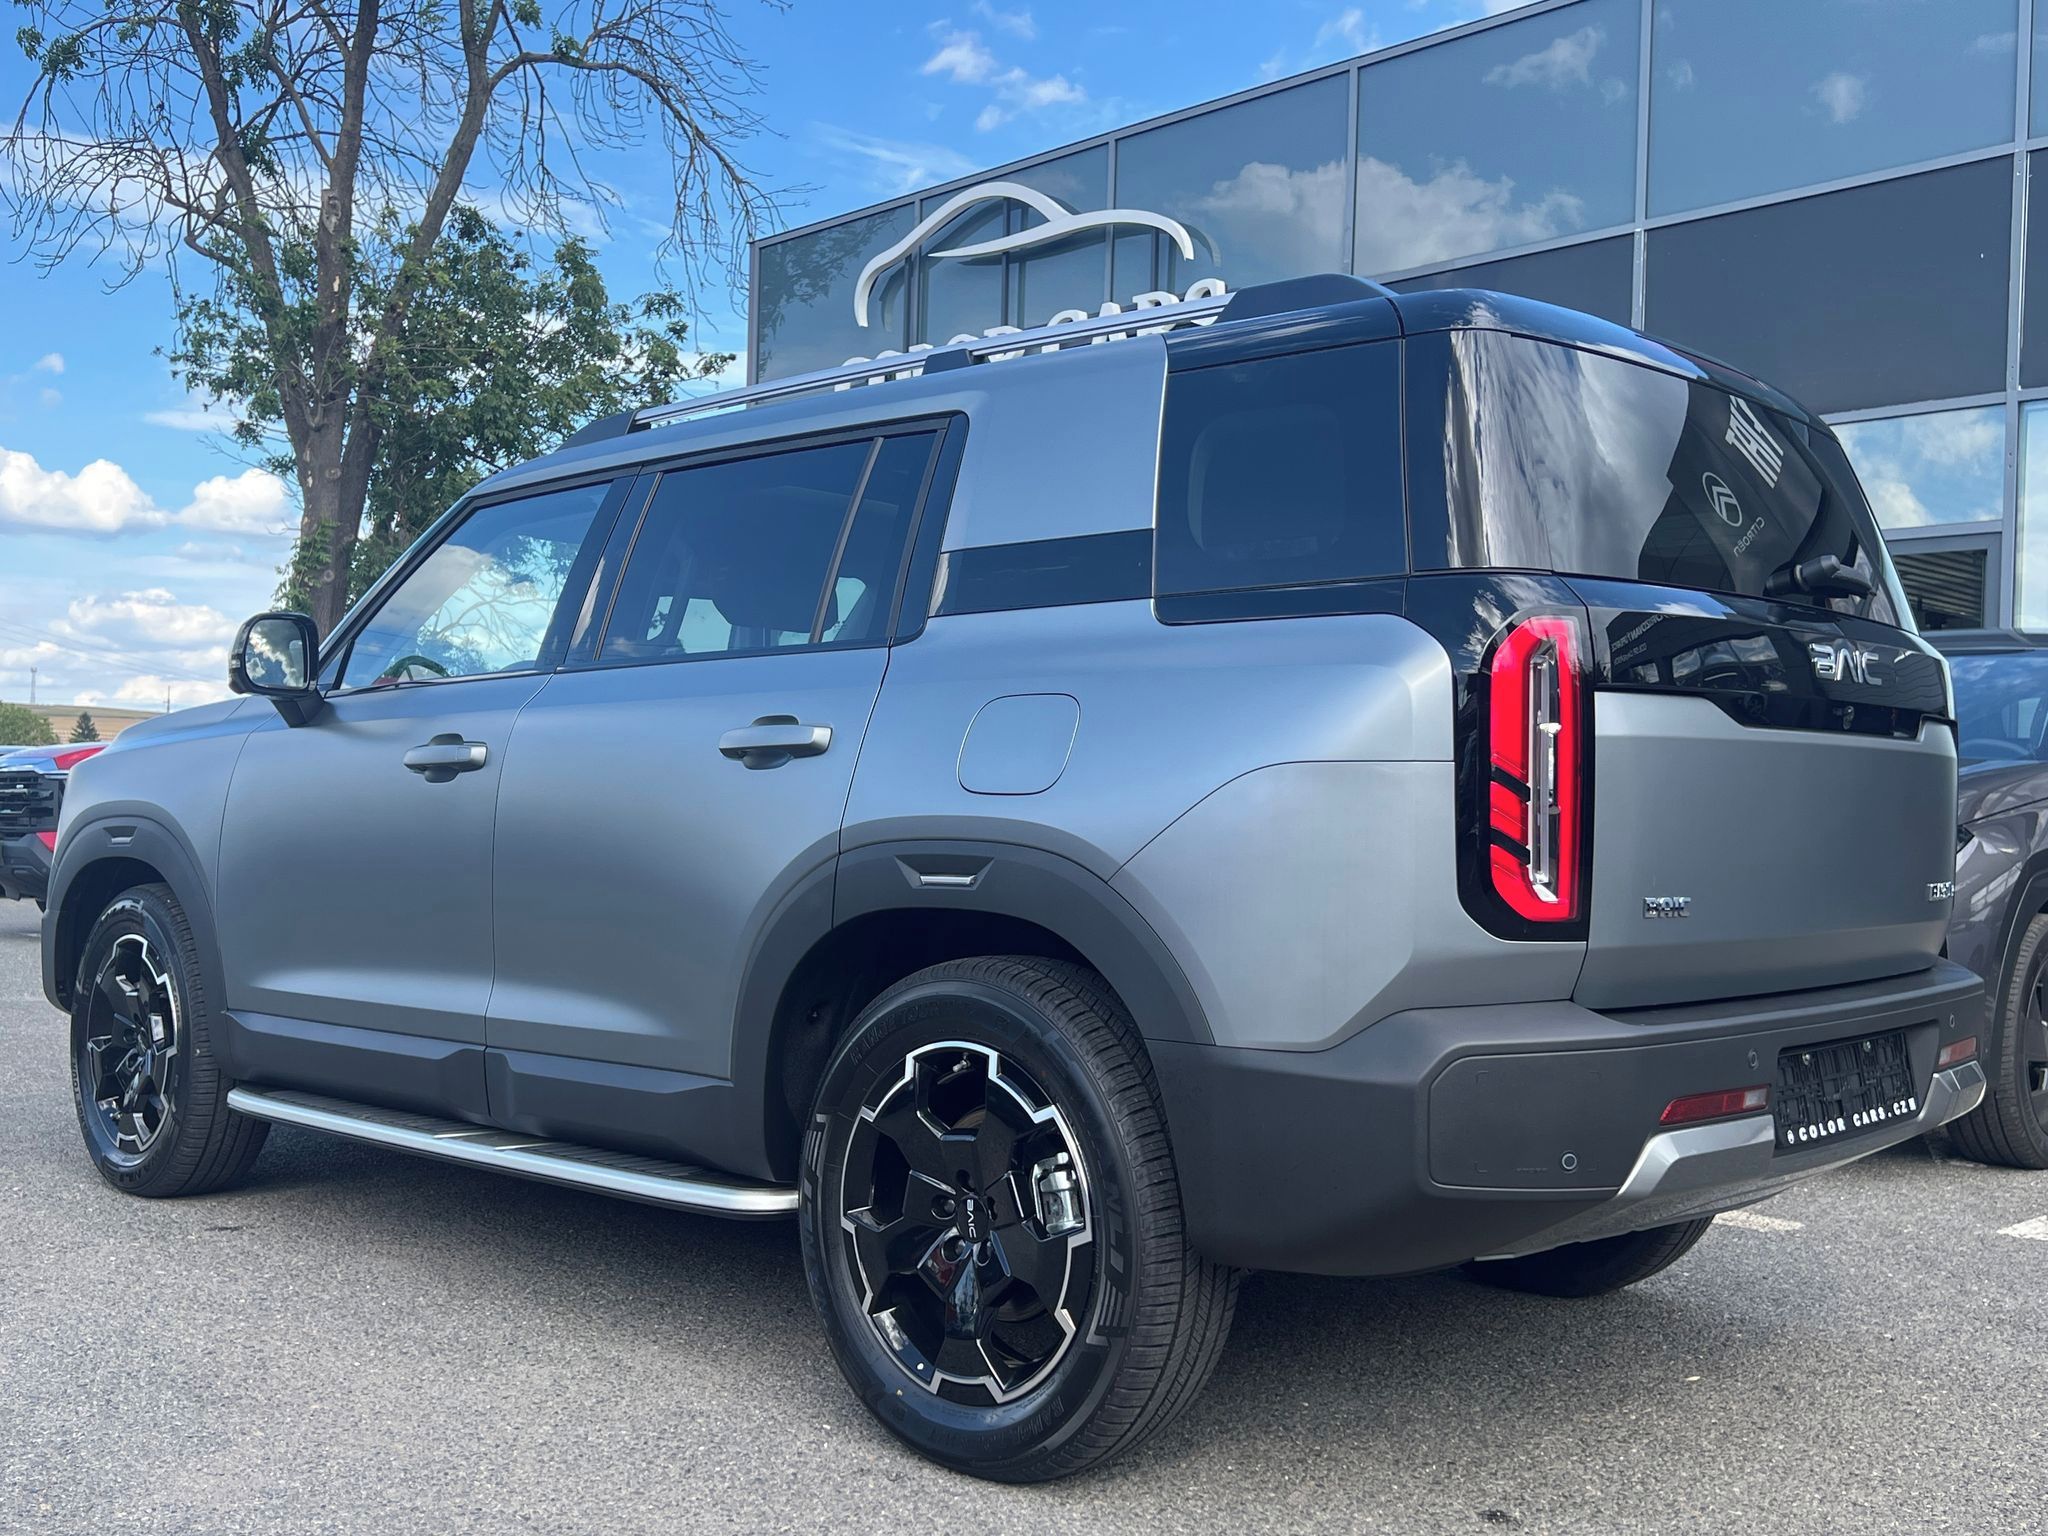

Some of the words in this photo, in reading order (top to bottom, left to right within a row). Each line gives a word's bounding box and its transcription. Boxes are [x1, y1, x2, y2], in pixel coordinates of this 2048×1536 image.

[1643, 896, 1692, 918] BAIC
[1798, 1117, 1847, 1142] COLOR
[1852, 1099, 1909, 1127] CARS.CZ
